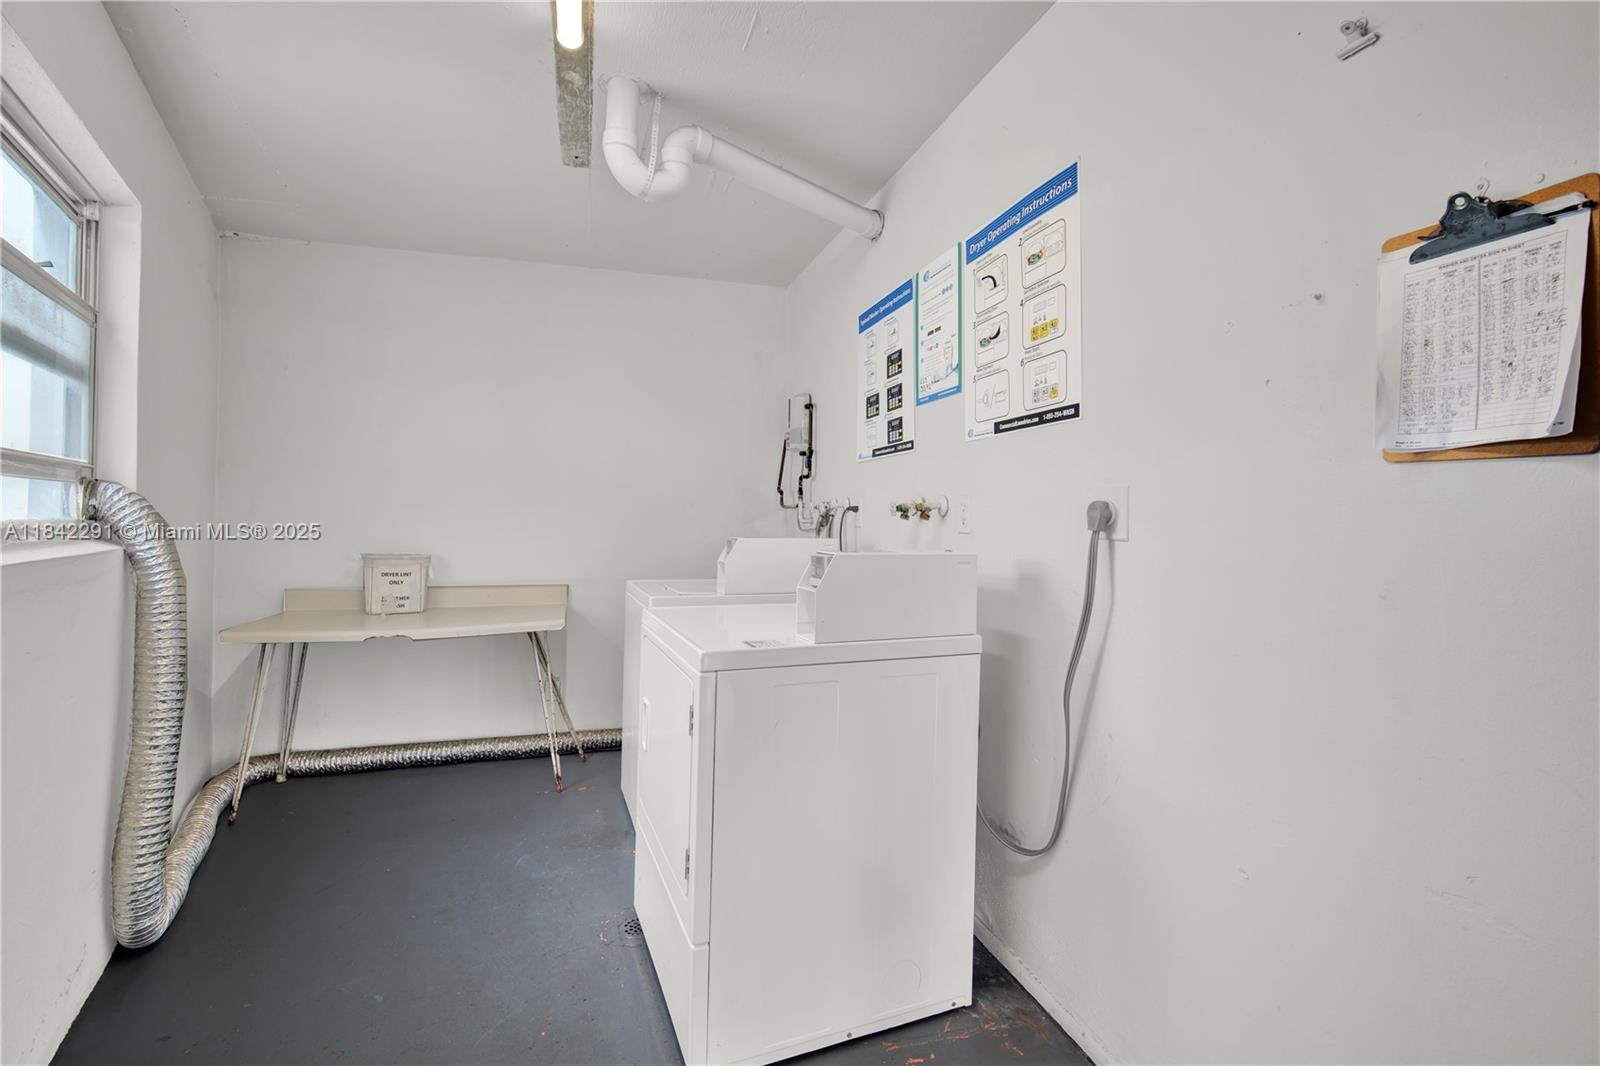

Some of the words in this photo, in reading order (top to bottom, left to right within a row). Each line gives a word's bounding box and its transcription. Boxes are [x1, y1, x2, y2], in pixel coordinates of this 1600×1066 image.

[969, 236, 988, 255] Dryer
[987, 212, 1021, 242] Operating
[1021, 179, 1072, 217] Instructions
[1018, 237, 1023, 247] 2
